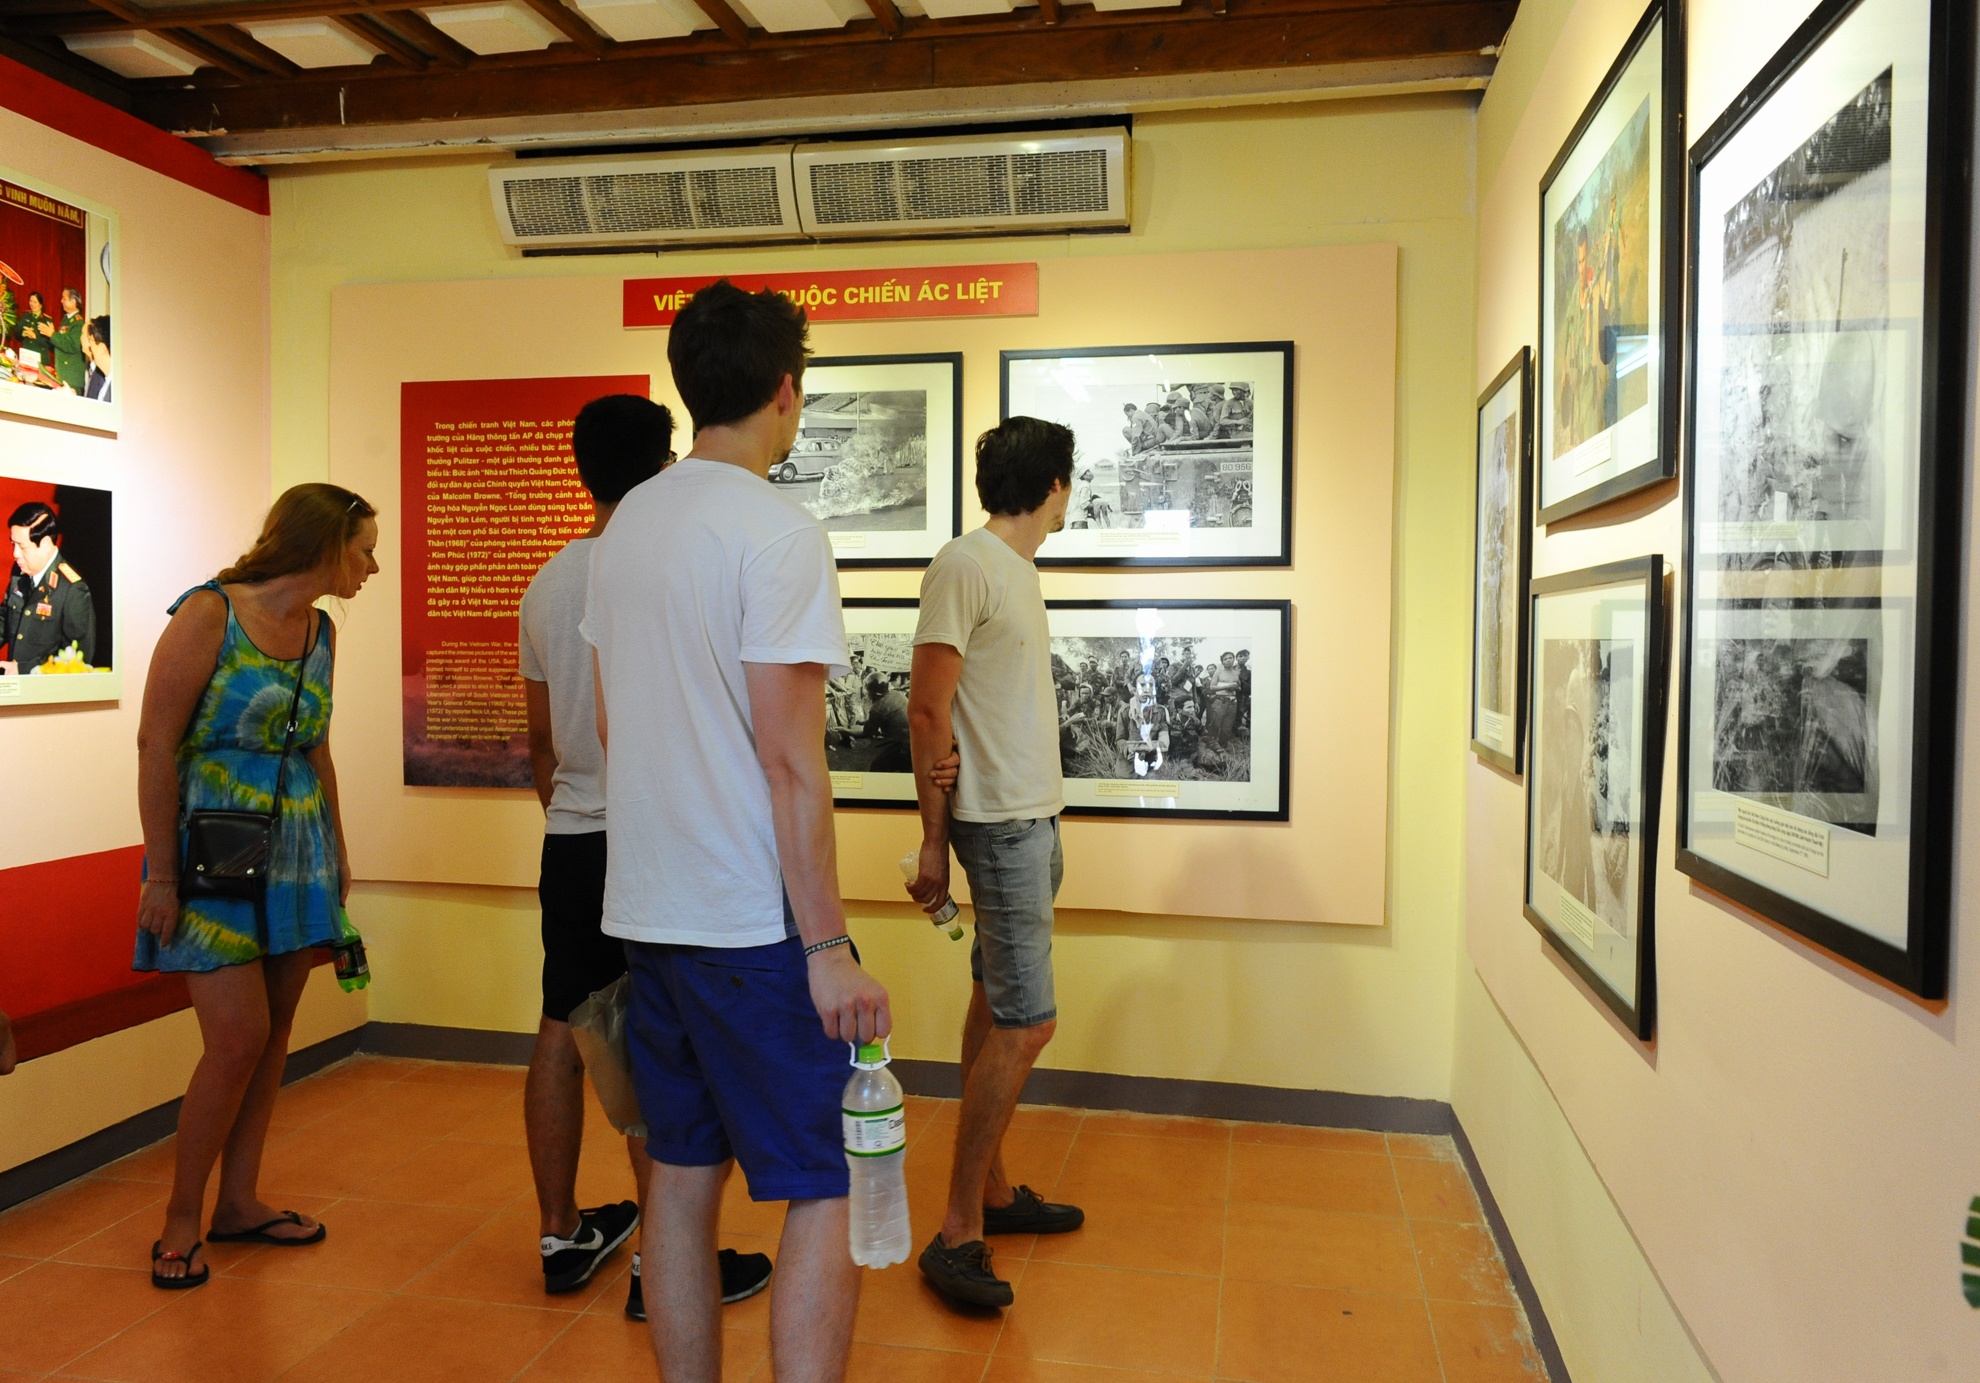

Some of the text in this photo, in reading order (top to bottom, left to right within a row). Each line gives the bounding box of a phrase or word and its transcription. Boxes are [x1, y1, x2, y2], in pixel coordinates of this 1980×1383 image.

[5, 186, 27, 204] VINH
[843, 278, 910, 304] CHIẾN
[917, 279, 950, 302] ÁC
[956, 277, 1004, 304] LIỆT
[557, 419, 575, 428] phón
